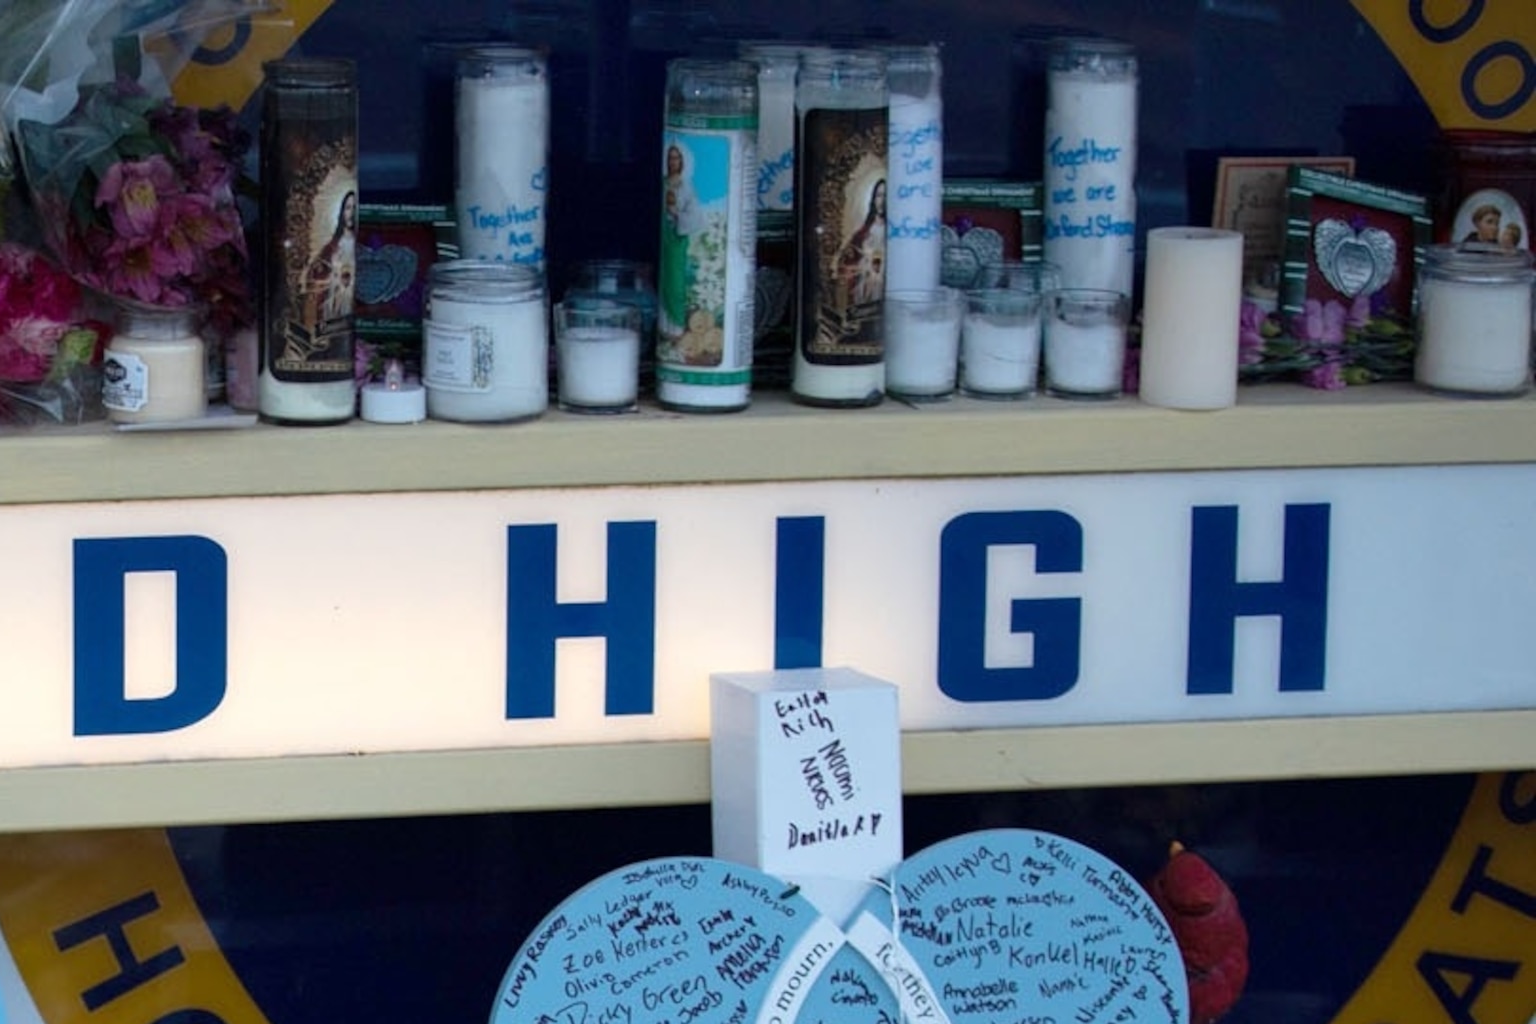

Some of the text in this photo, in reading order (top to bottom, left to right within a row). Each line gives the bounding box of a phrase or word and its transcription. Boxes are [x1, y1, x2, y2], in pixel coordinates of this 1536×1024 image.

[506, 502, 1330, 722] HIGH
[955, 911, 1034, 943] Natalie
[641, 973, 710, 1013] Green
[775, 940, 835, 1015] mourn,
